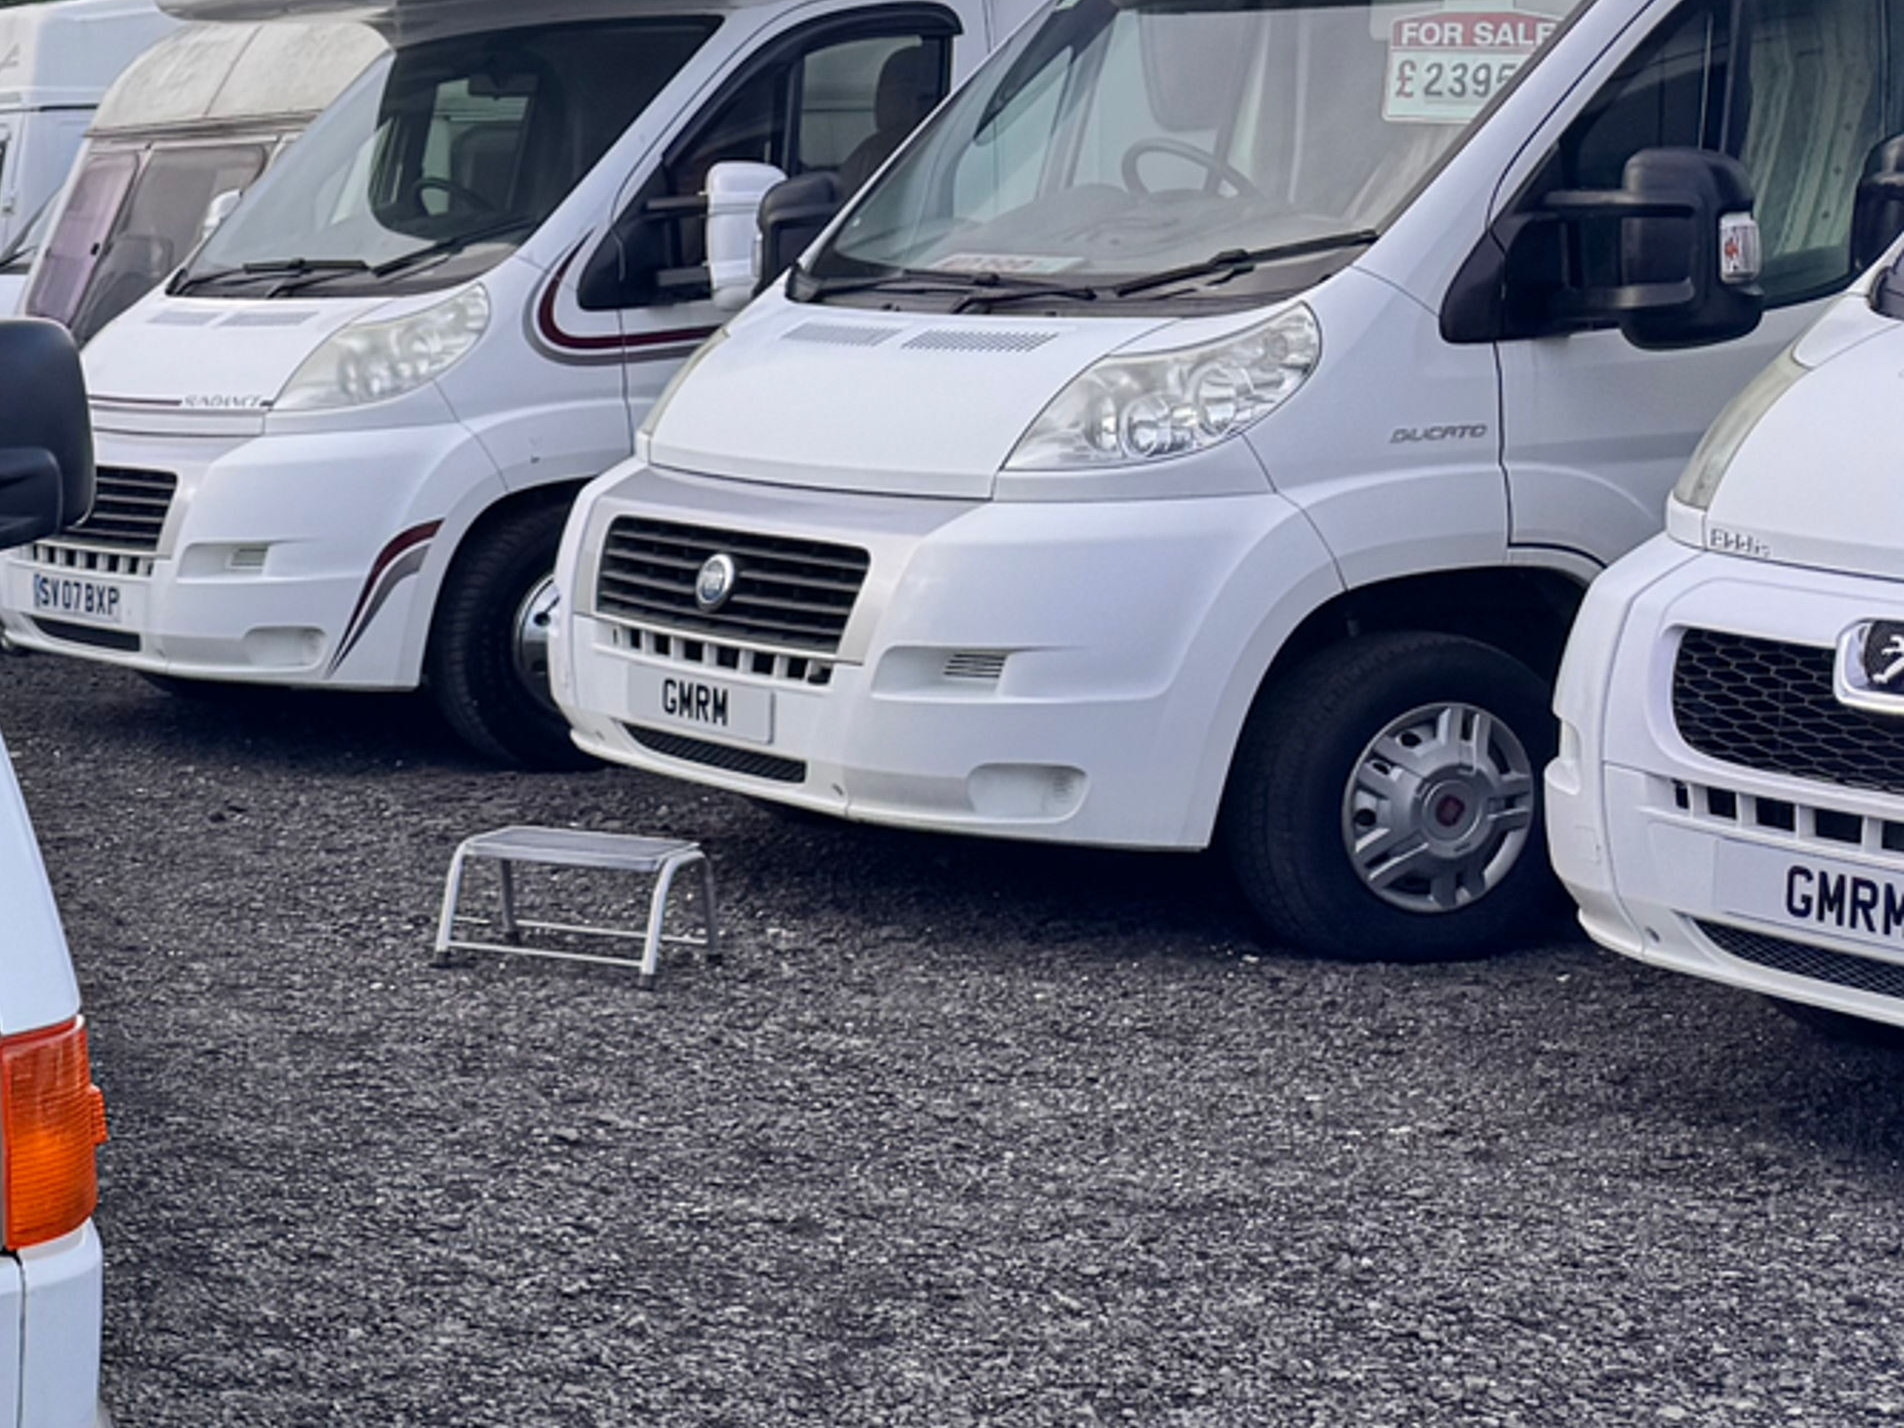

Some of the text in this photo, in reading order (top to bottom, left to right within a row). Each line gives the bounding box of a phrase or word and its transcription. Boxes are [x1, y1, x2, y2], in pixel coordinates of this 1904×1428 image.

[1401, 22, 1463, 45] FOR
[1390, 424, 1488, 444] DUCATO
[662, 678, 728, 726] GMRM
[1787, 865, 1904, 935] GMRM
